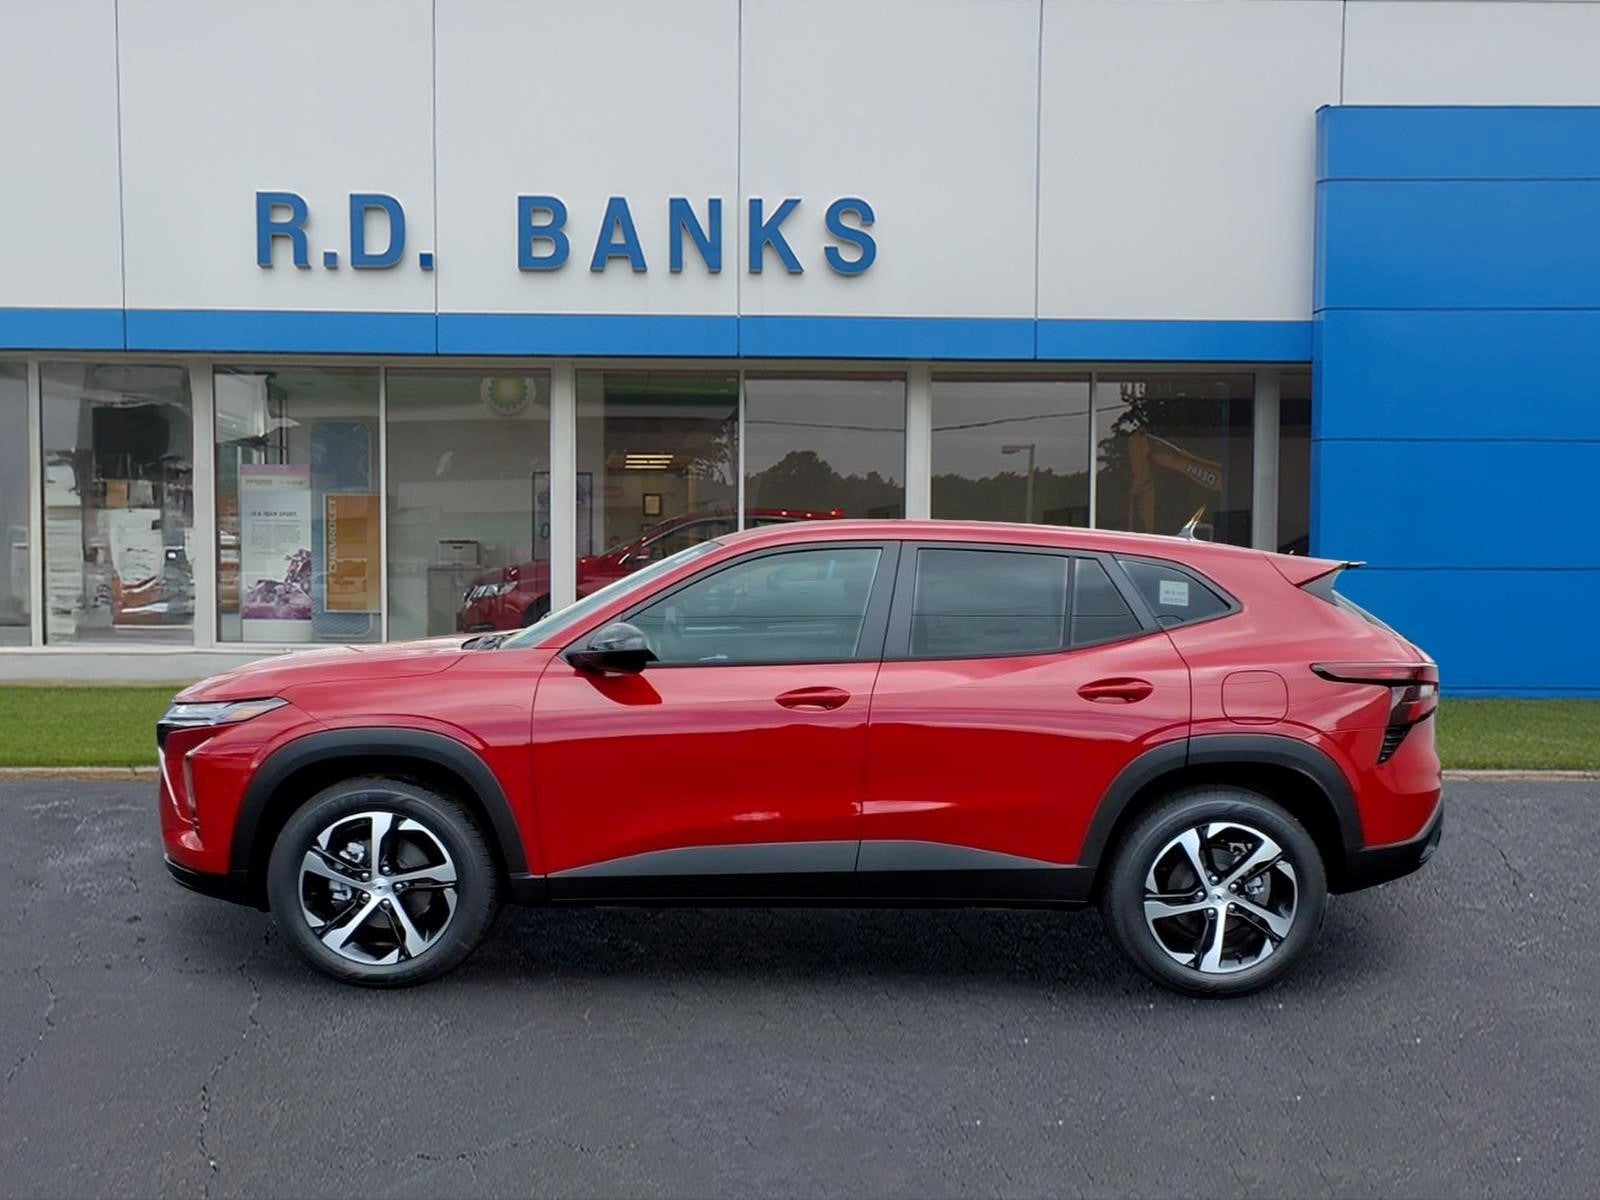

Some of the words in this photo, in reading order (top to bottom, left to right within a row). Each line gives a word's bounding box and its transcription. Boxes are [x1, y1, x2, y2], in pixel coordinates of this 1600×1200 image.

[255, 191, 434, 271] R.D.
[517, 195, 878, 278] BANKS
[328, 498, 337, 573] CHEVROLET
